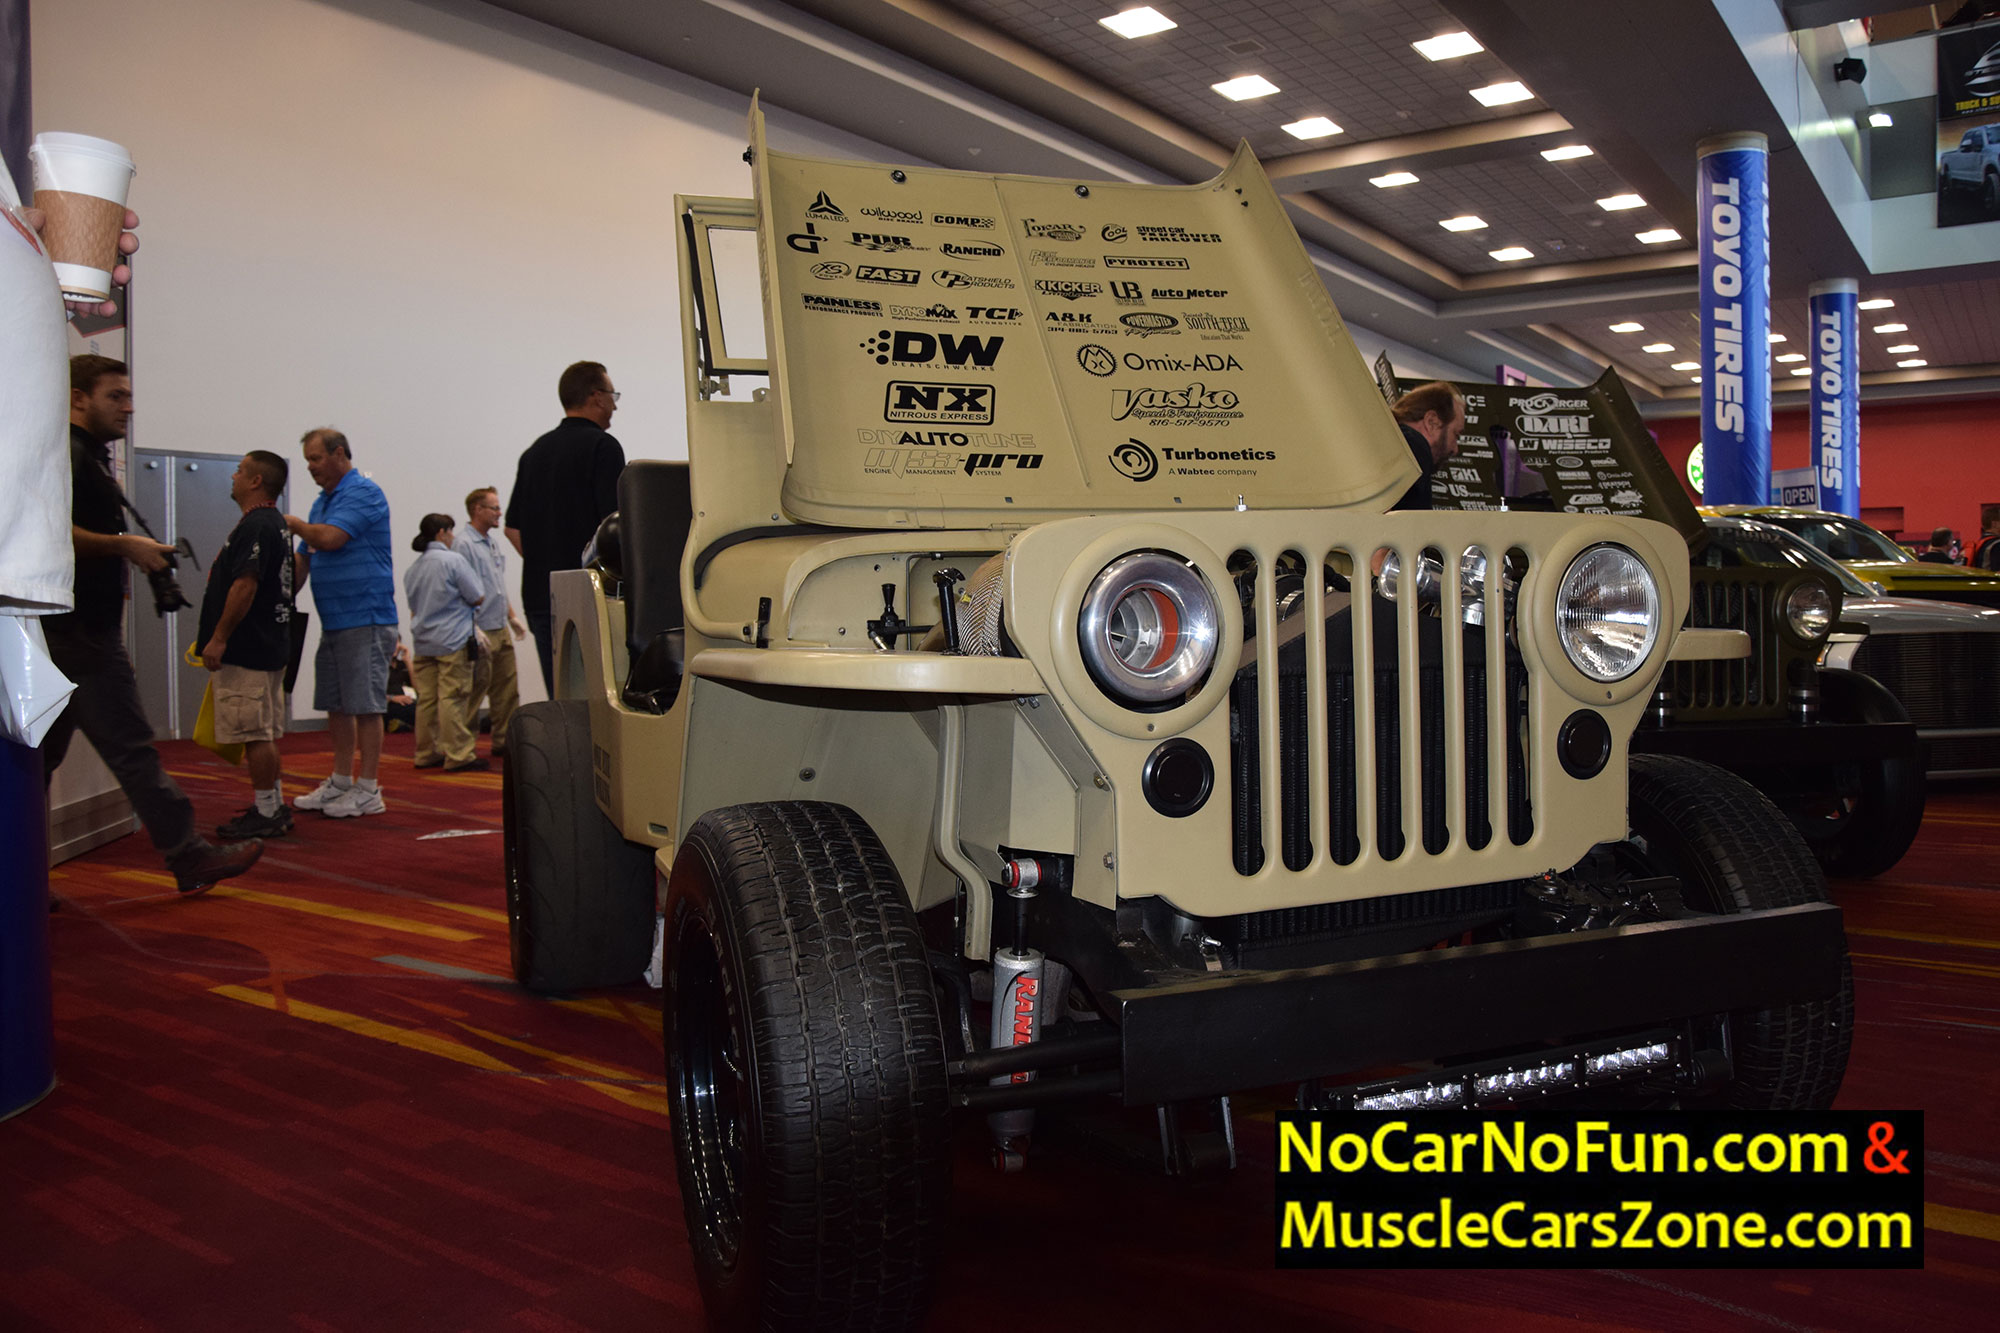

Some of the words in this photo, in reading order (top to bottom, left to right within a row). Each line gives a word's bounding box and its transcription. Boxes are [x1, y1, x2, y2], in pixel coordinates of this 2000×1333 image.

[860, 206, 923, 220] wilwood
[934, 215, 981, 226] COMP
[1711, 177, 1743, 298] TOYO
[943, 243, 1002, 257] RANCHO
[814, 262, 843, 275] XS
[1106, 258, 1185, 267] PYROTECT
[858, 267, 918, 282] FAST
[1037, 280, 1102, 294] KICKER
[803, 294, 881, 311] PAINLESS
[804, 304, 849, 315] PERFORMANCE
[850, 309, 884, 318] PRODUCTS
[891, 330, 1004, 367] DW
[1820, 310, 1842, 395] TOYO
[891, 361, 995, 372] DEATSCHWERKS
[1123, 352, 1243, 371] Omix-ADA
[1713, 303, 1744, 434] TIRES
[893, 385, 988, 412] NX
[1111, 382, 1240, 421] Vasko
[890, 411, 937, 419] NITROUS
[940, 412, 989, 421] EXPRESS
[1131, 408, 1166, 420] Speed
[1176, 408, 1244, 421] Performance
[1149, 419, 1230, 428] 816-517-9570
[1523, 415, 1591, 433] DART
[857, 428, 1036, 448] DIYAUTOTUNE
[1821, 399, 1843, 491] TIRES
[1162, 447, 1276, 461] Turbonetics
[905, 468, 957, 476] MANAGEMENT
[1168, 467, 1176, 476] A
[1177, 467, 1215, 476] Wabtec
[1217, 468, 1257, 477] company
[1784, 486, 1815, 505] OPEN
